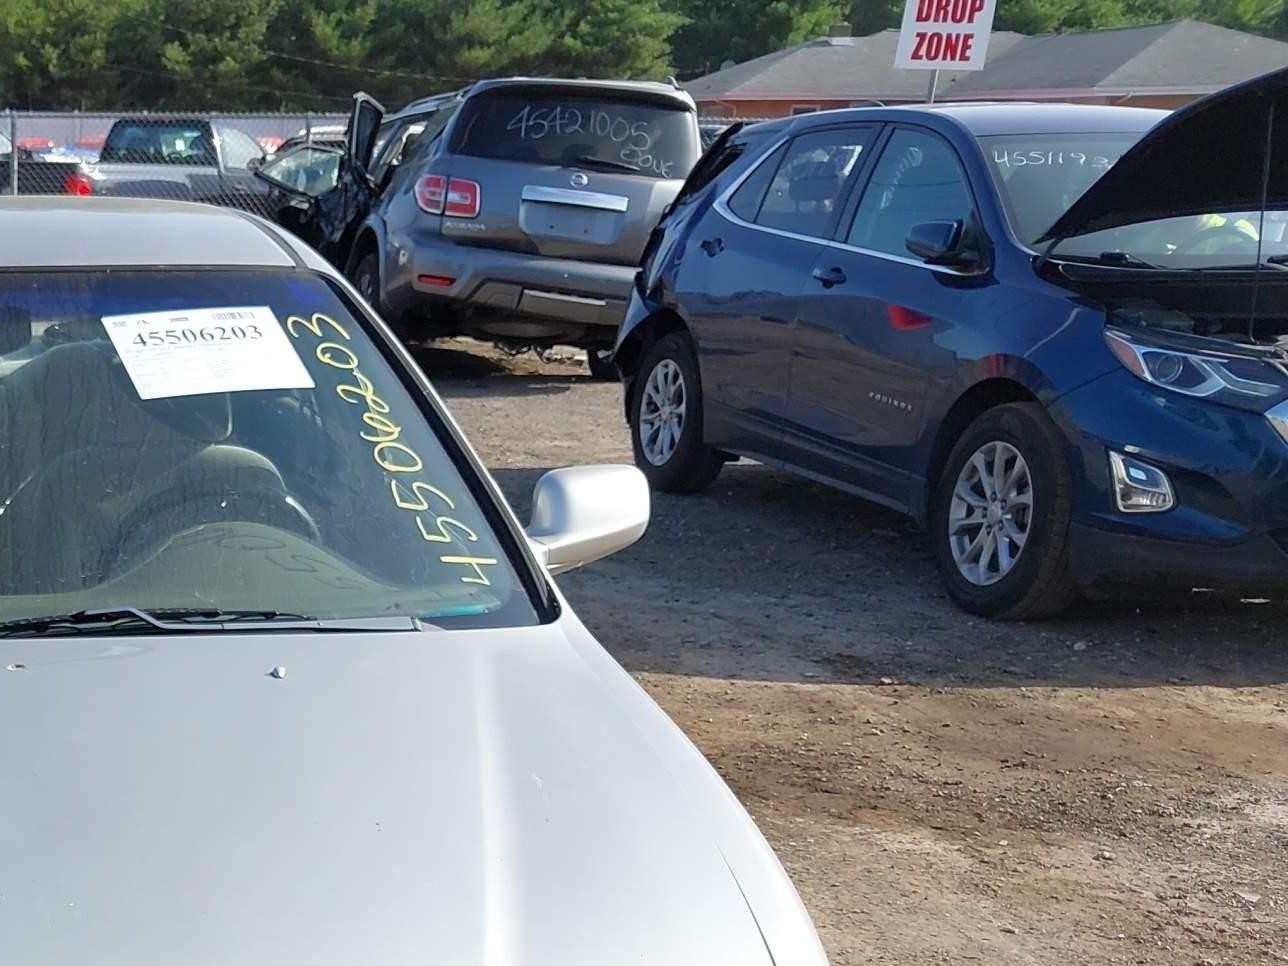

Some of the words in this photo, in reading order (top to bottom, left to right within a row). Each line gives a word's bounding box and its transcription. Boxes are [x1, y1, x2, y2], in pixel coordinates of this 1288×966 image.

[915, 0, 985, 24] DROP
[911, 32, 975, 61] ZONE
[506, 105, 651, 151] 45421005
[132, 324, 264, 347] 45506203
[287, 312, 498, 587] 45506203
